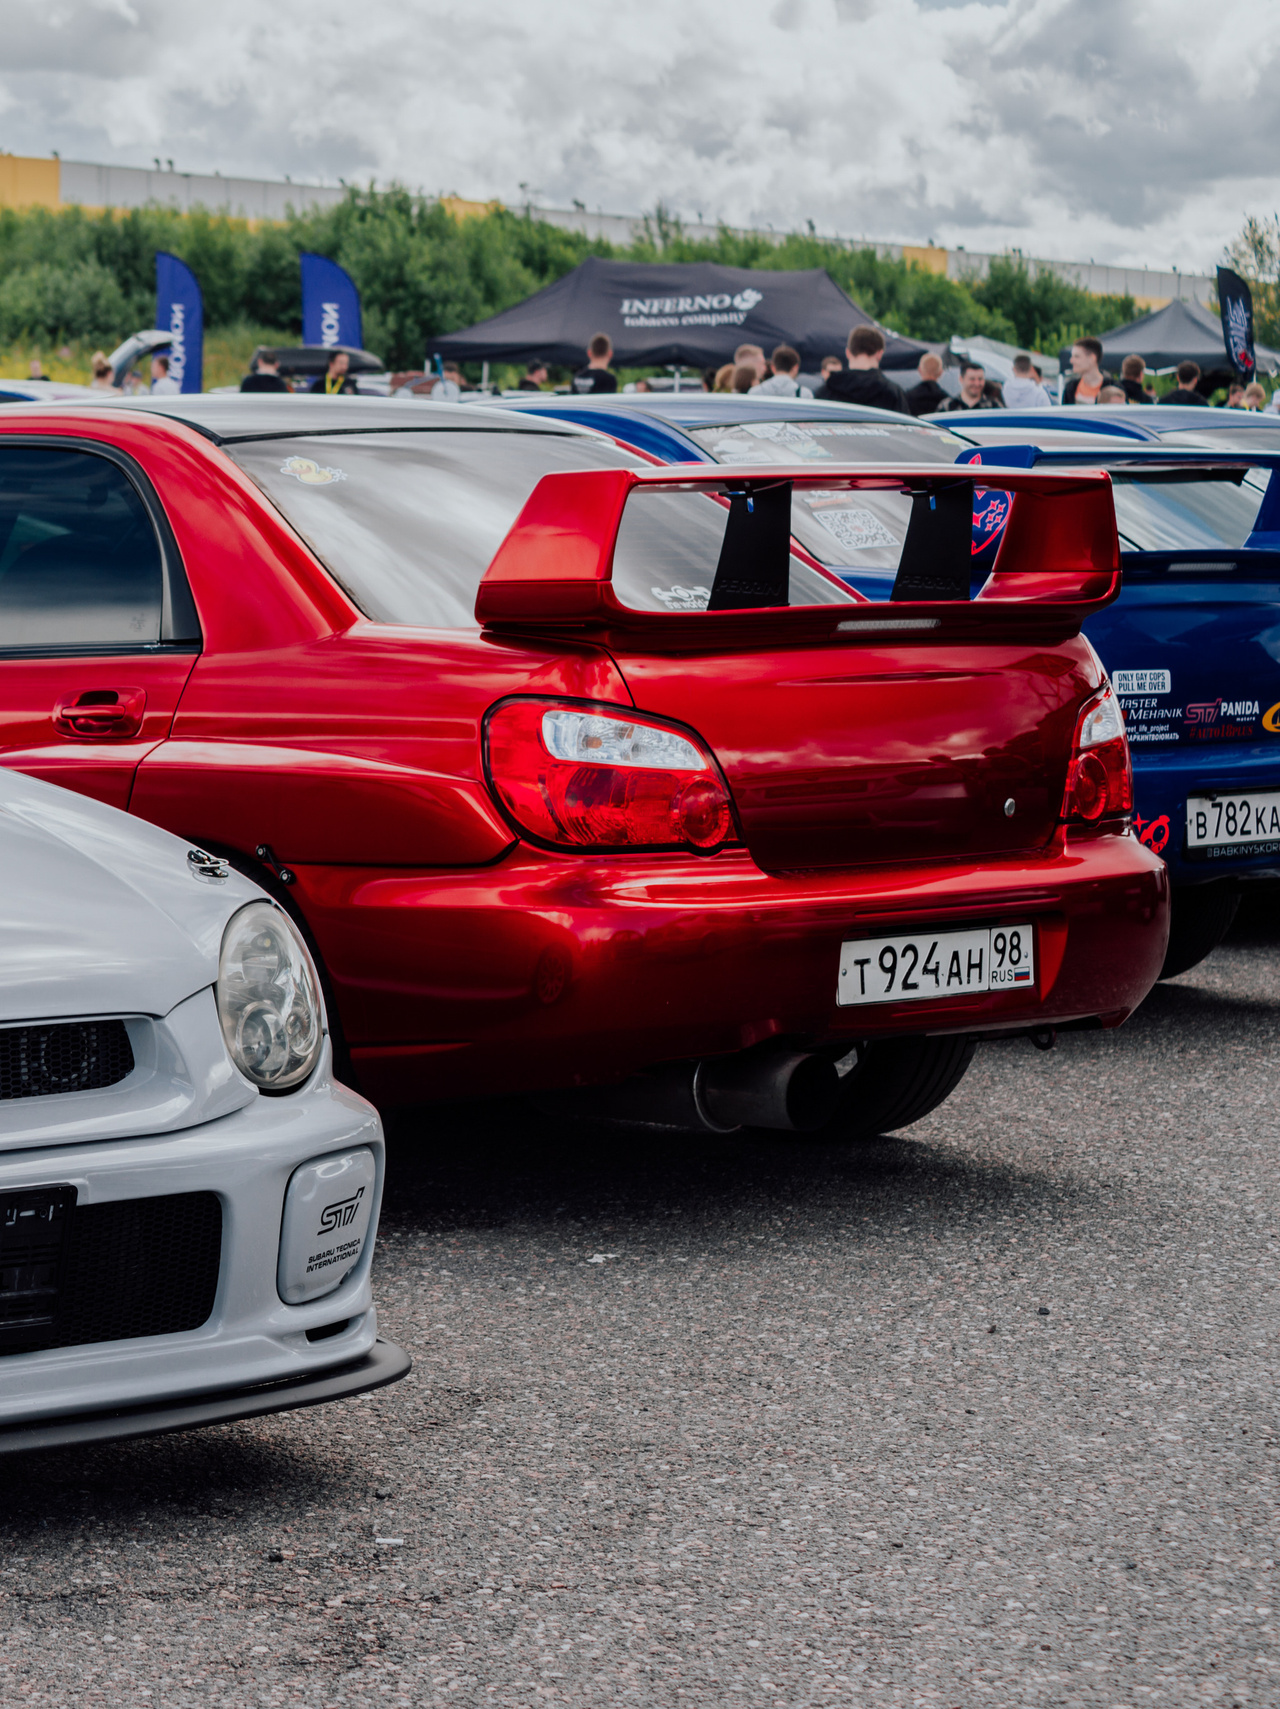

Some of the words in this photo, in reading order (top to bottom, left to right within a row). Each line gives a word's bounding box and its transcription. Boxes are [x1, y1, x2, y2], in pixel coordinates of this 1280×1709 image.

[621, 294, 731, 314] INFERNO
[624, 315, 679, 327] tobacco
[681, 312, 747, 327] company
[1118, 673, 1134, 681] ONLY
[1136, 672, 1147, 681] GAY
[1149, 672, 1165, 681] COPS
[1118, 682, 1135, 691] PULL
[1137, 682, 1146, 690] ME
[1149, 682, 1165, 690] OVER
[1221, 700, 1259, 716] PANIDA
[1213, 842, 1280, 857] BABKINYSKOR
[994, 930, 1022, 968] 98
[992, 970, 1013, 983] RUS
[308, 1248, 335, 1264] SUBARU
[336, 1238, 361, 1252] TECNICA
[306, 1248, 359, 1273] INTERNATIONAL
